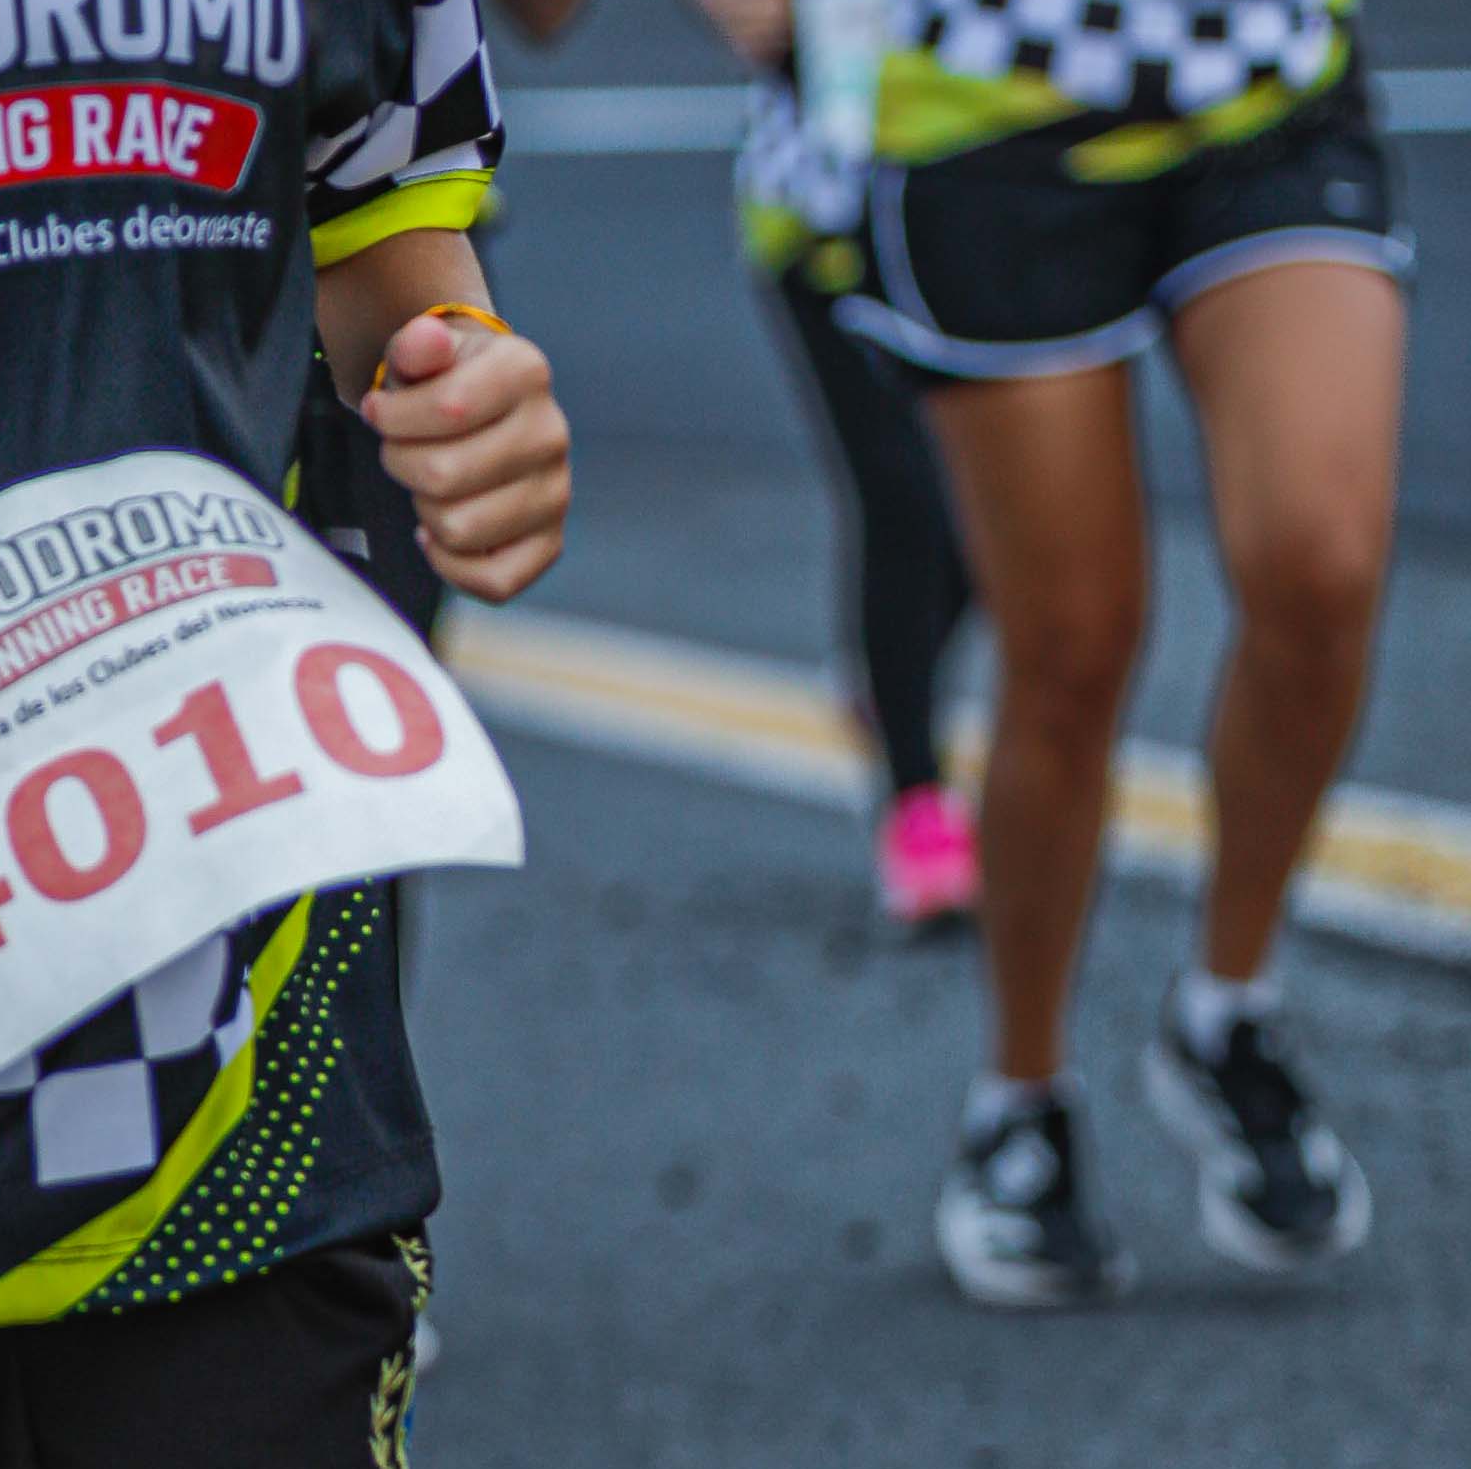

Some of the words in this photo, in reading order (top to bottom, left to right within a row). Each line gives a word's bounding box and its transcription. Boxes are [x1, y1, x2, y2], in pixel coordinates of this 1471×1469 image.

[118, 554, 234, 614] RACE
[13, 698, 46, 725] de
[47, 675, 86, 705] los
[87, 634, 171, 685] Clubes
[175, 609, 213, 641] del
